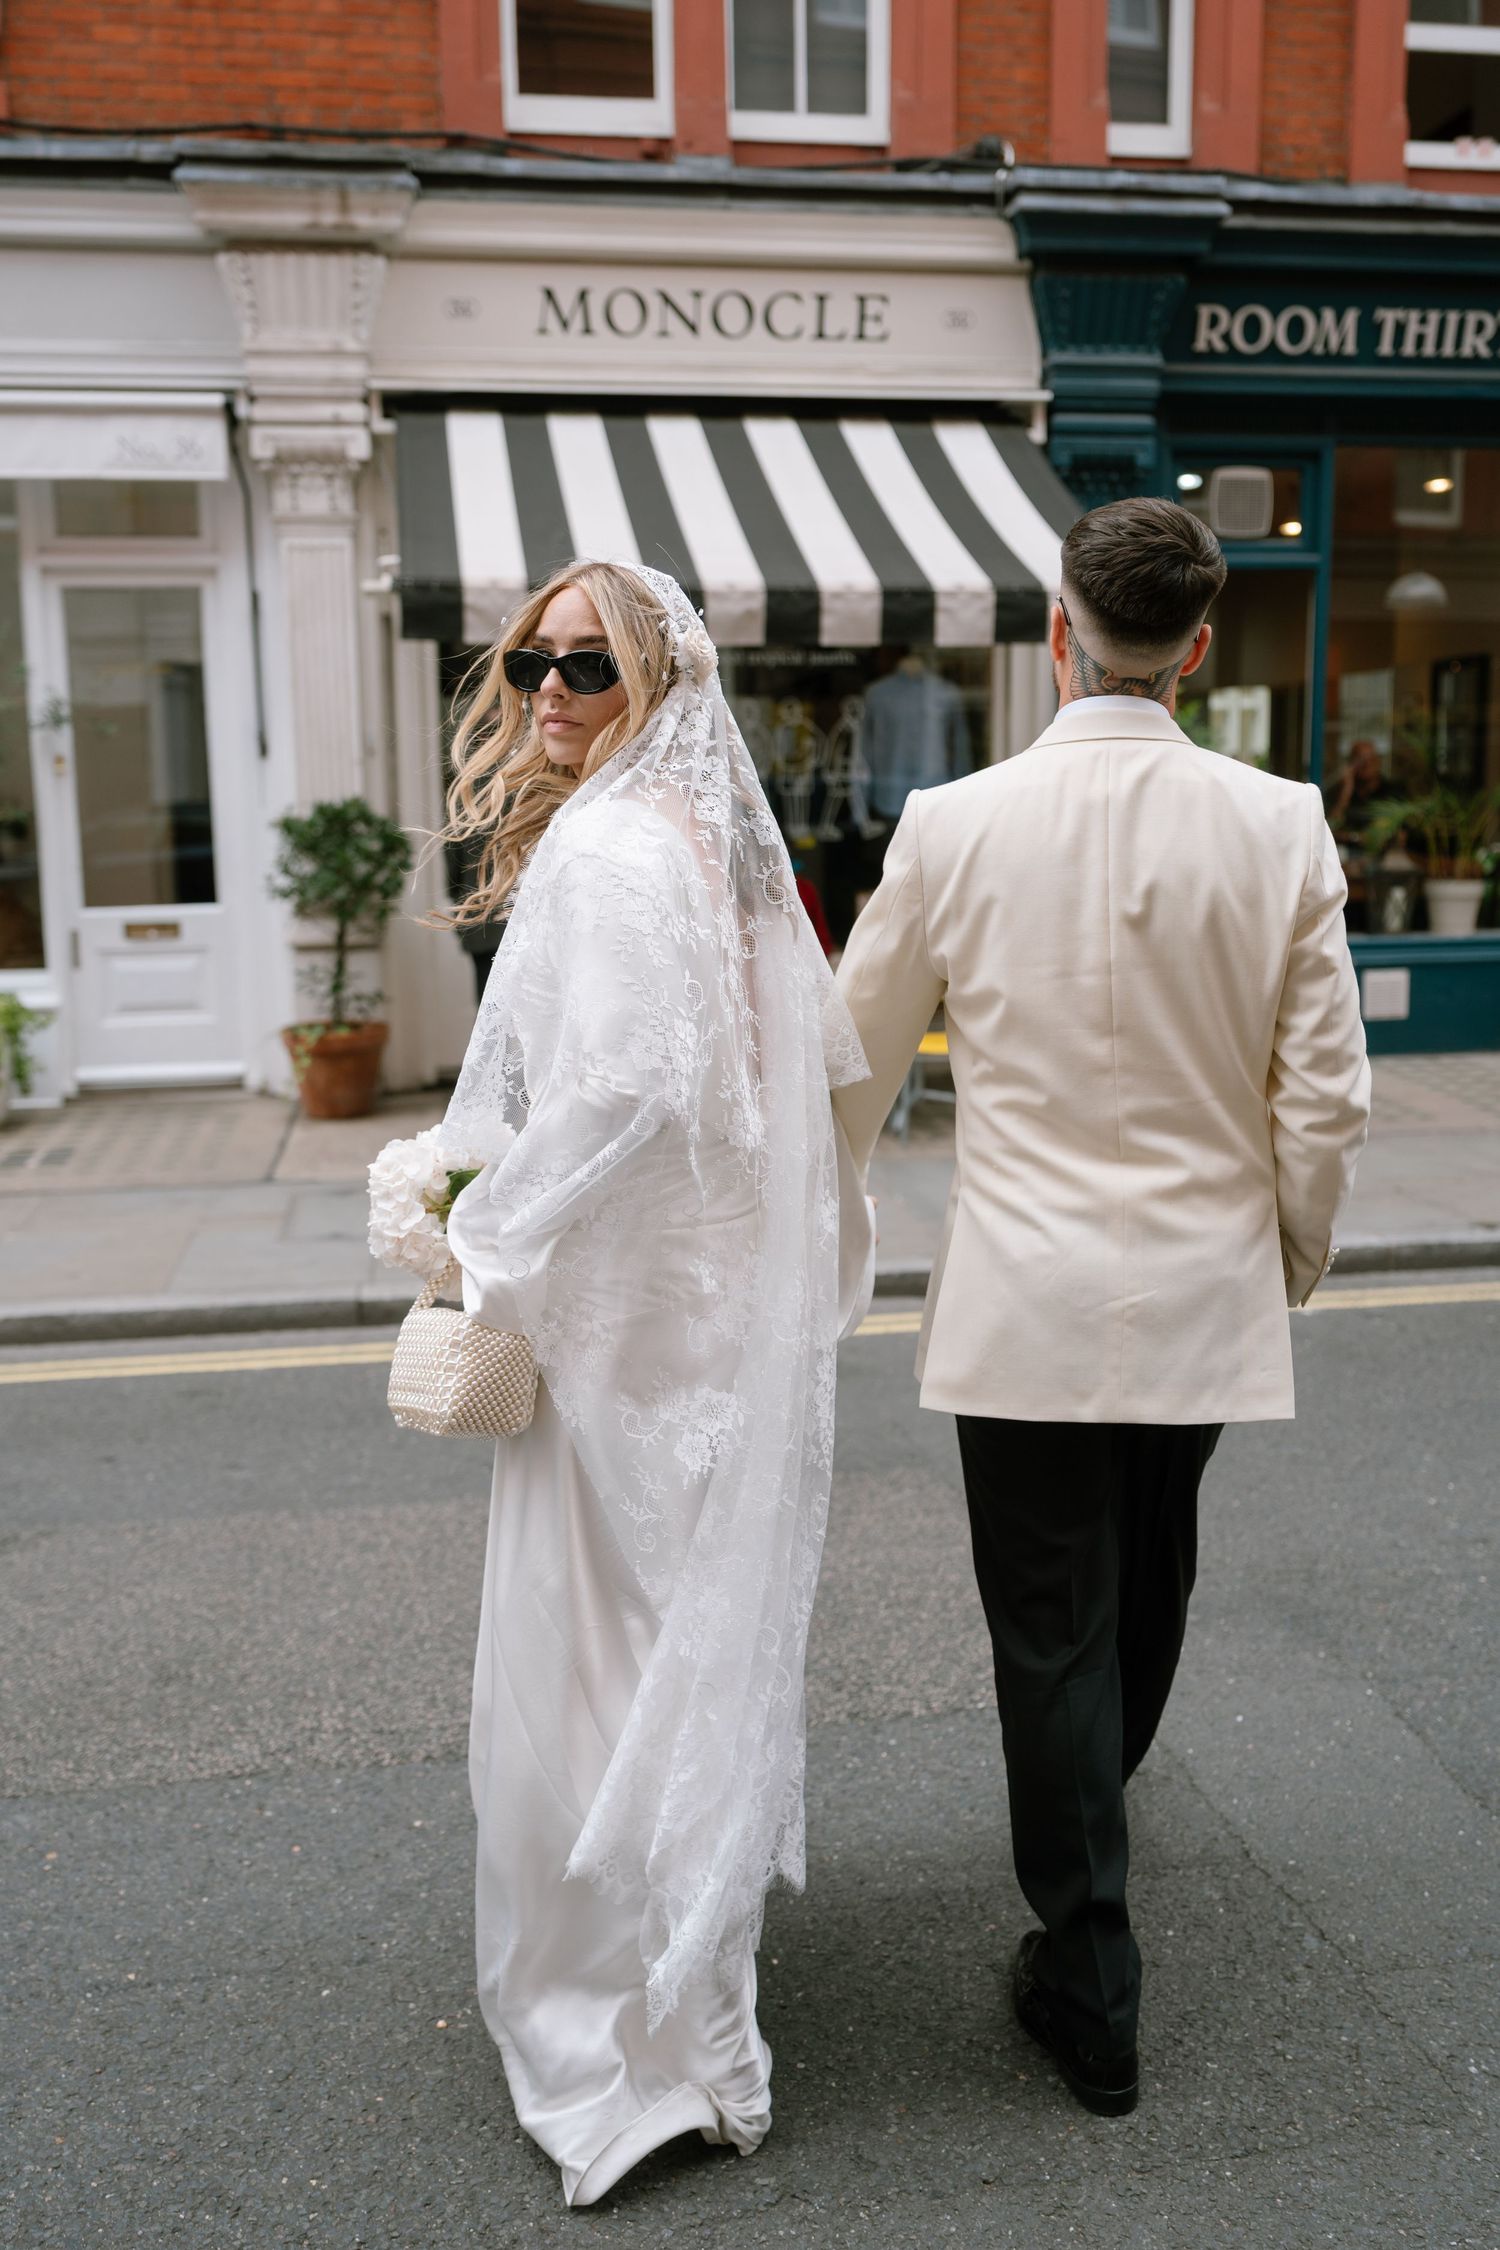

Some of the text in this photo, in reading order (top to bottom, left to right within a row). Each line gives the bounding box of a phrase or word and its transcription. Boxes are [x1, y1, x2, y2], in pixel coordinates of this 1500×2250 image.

[537, 285, 891, 343] MONOCLE
[1192, 303, 1500, 358] ROOM THIR
